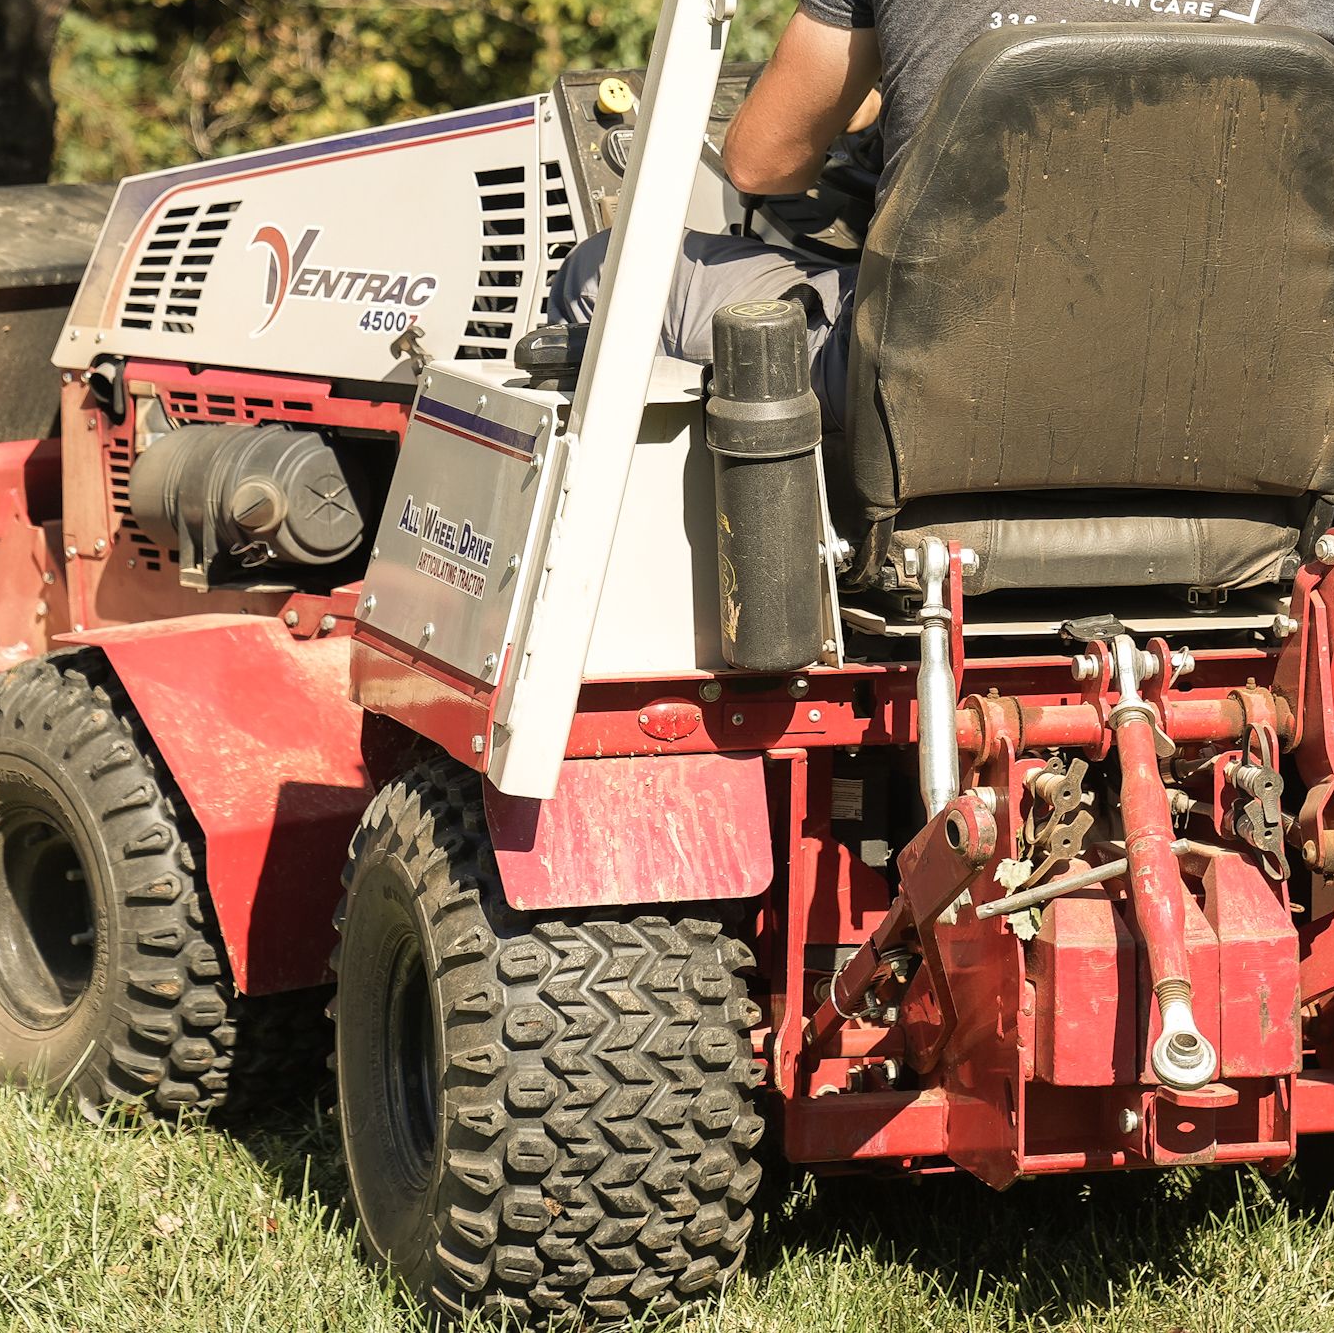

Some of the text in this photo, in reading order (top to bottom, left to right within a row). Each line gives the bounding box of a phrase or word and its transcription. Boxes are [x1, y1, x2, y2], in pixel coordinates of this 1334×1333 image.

[251, 226, 437, 336] VENTRAC
[417, 551, 485, 597] ARTICULATING TRACTOR
